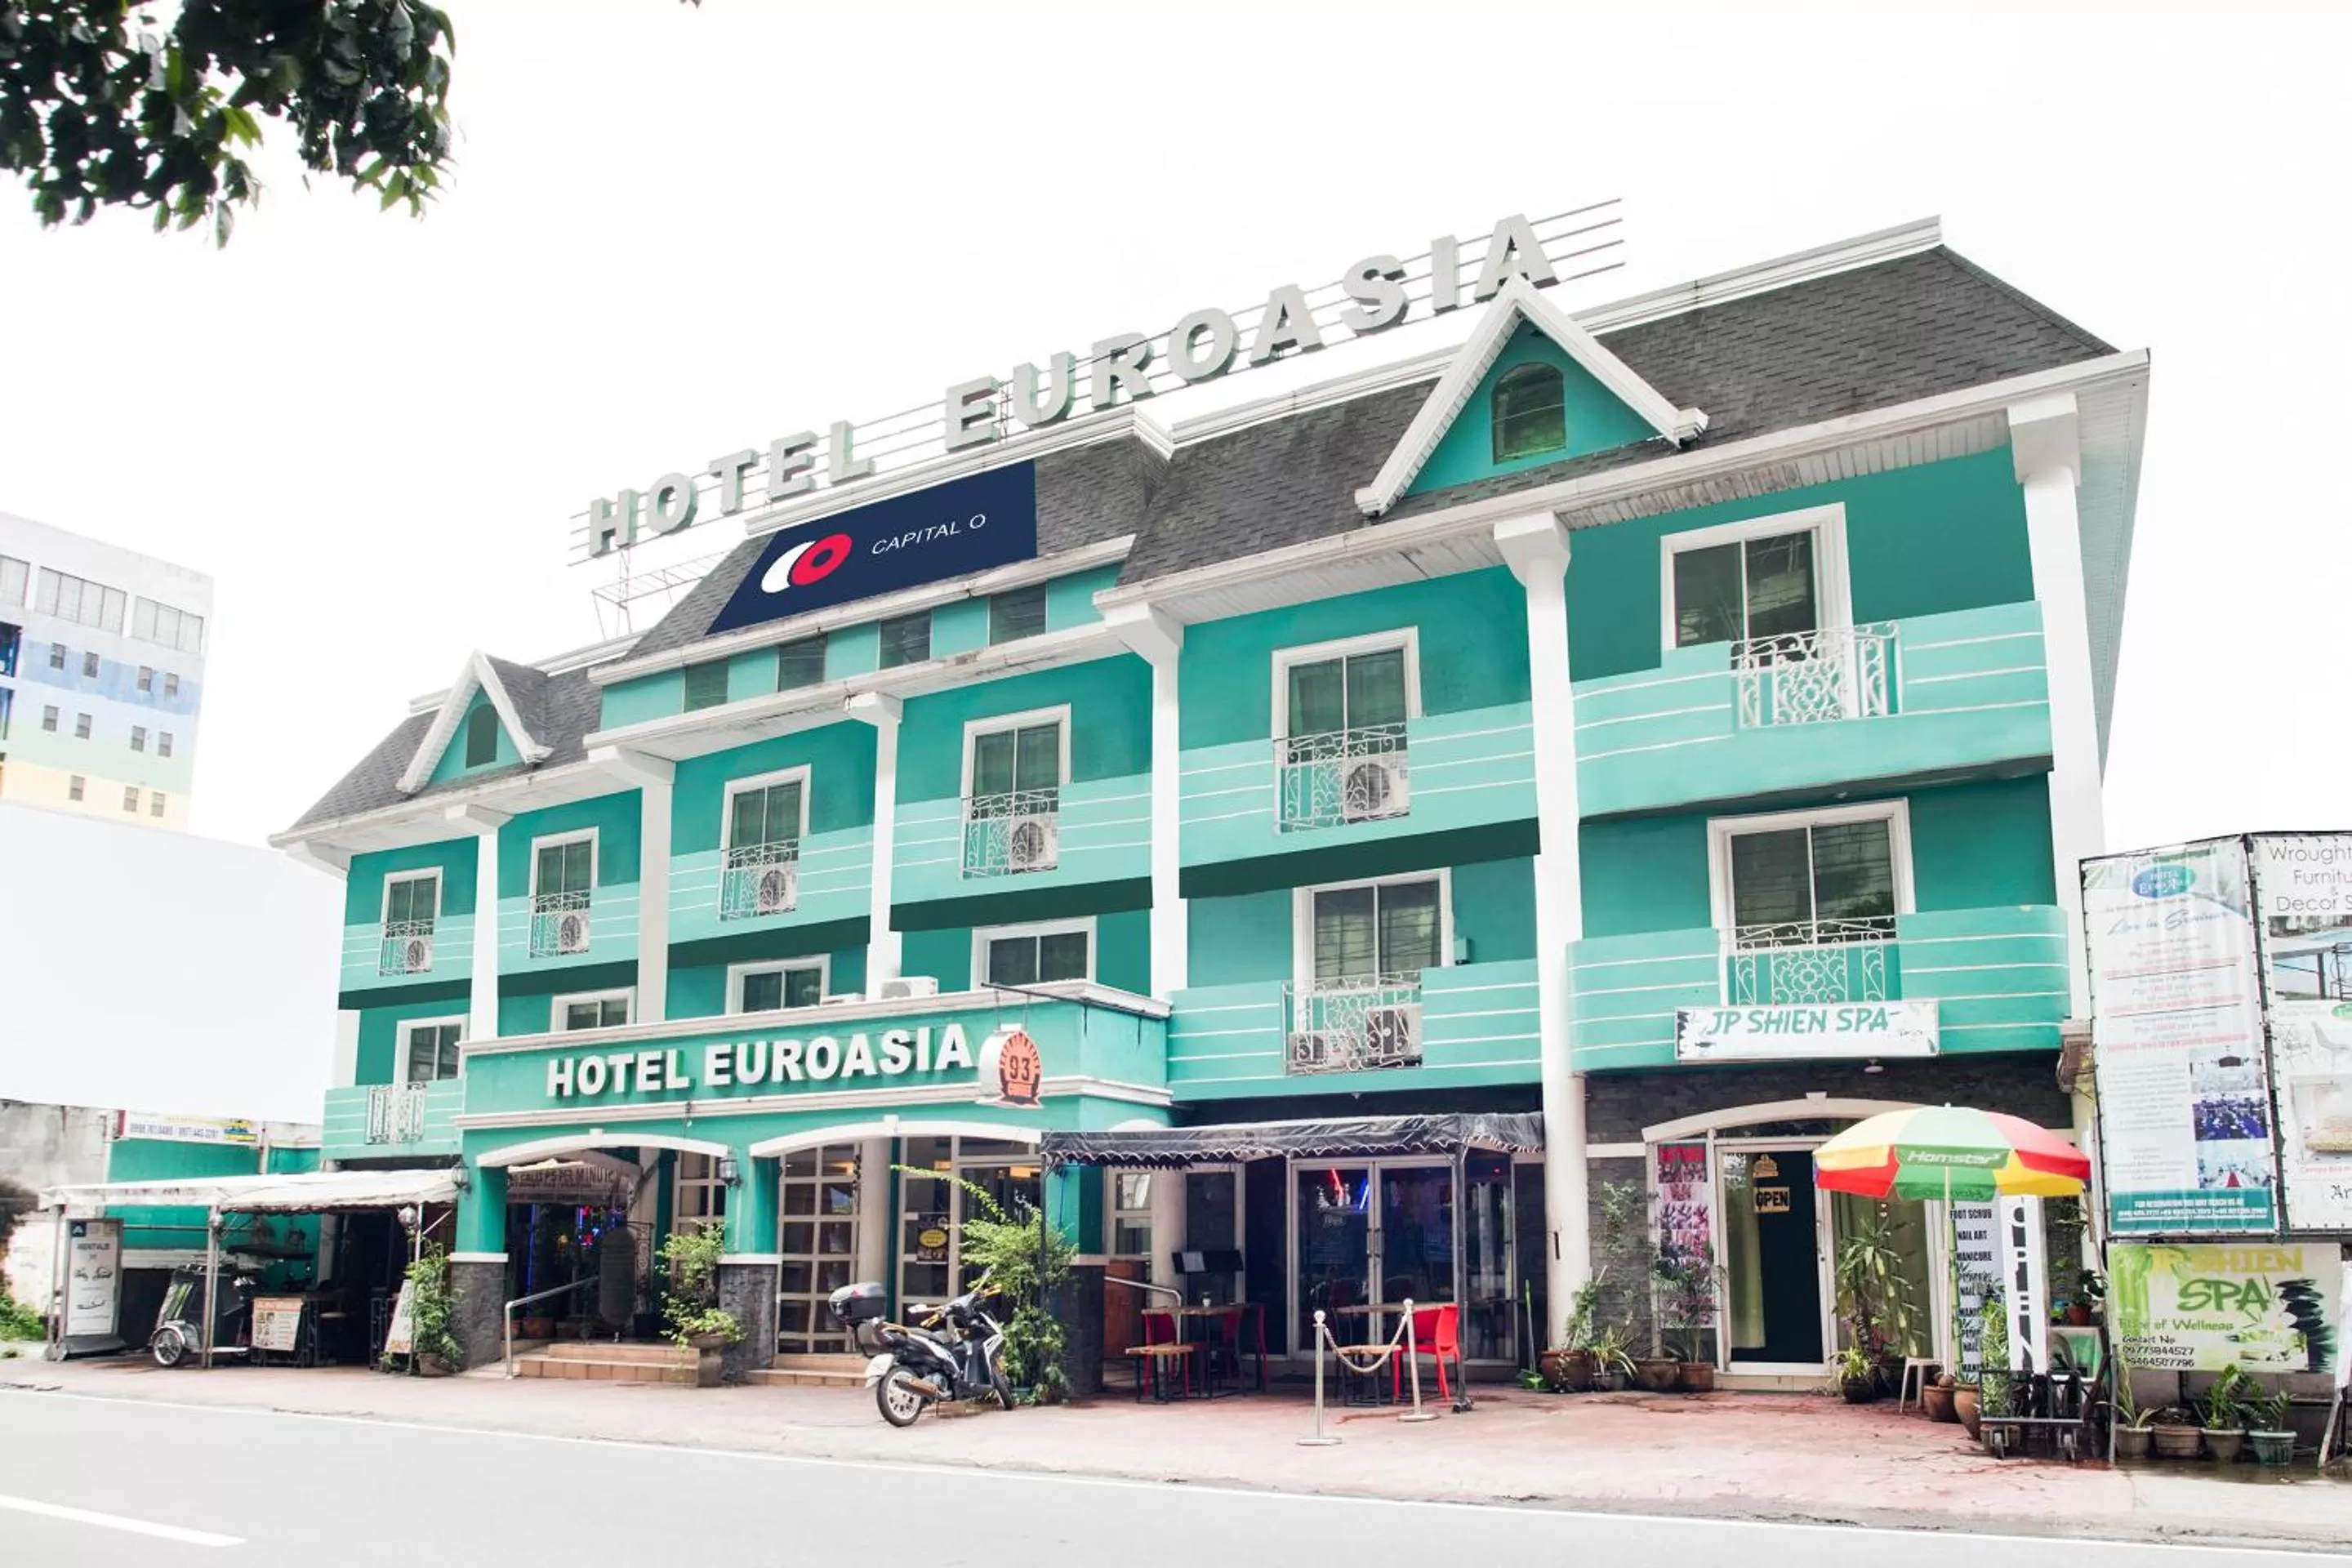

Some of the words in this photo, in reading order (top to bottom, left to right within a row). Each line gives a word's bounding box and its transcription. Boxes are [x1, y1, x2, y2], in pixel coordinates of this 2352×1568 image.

[589, 420, 875, 558] HOTEL
[945, 213, 1560, 452] EUROASIA
[871, 521, 961, 555] CAPITAL
[969, 514, 986, 529] O
[2269, 845, 2352, 864] Wrought
[2276, 897, 2337, 911] Decor
[1706, 1011, 1741, 1036] JP
[1746, 1009, 1828, 1034] SHIEN
[1835, 1008, 1889, 1032] SPA
[546, 1049, 691, 1098] HOTEL
[704, 1023, 974, 1086] EUROASIA
[1009, 1055, 1031, 1081] 93
[1907, 1151, 2001, 1165] Hamster
[1756, 1191, 1788, 1207] OPEN
[1968, 1209, 1992, 1219] SCRUB
[1958, 1231, 1972, 1241] NAIL
[1974, 1230, 1987, 1240] ART
[2177, 1277, 2269, 1312] SPA
[2173, 1317, 2234, 1331] Wellness
